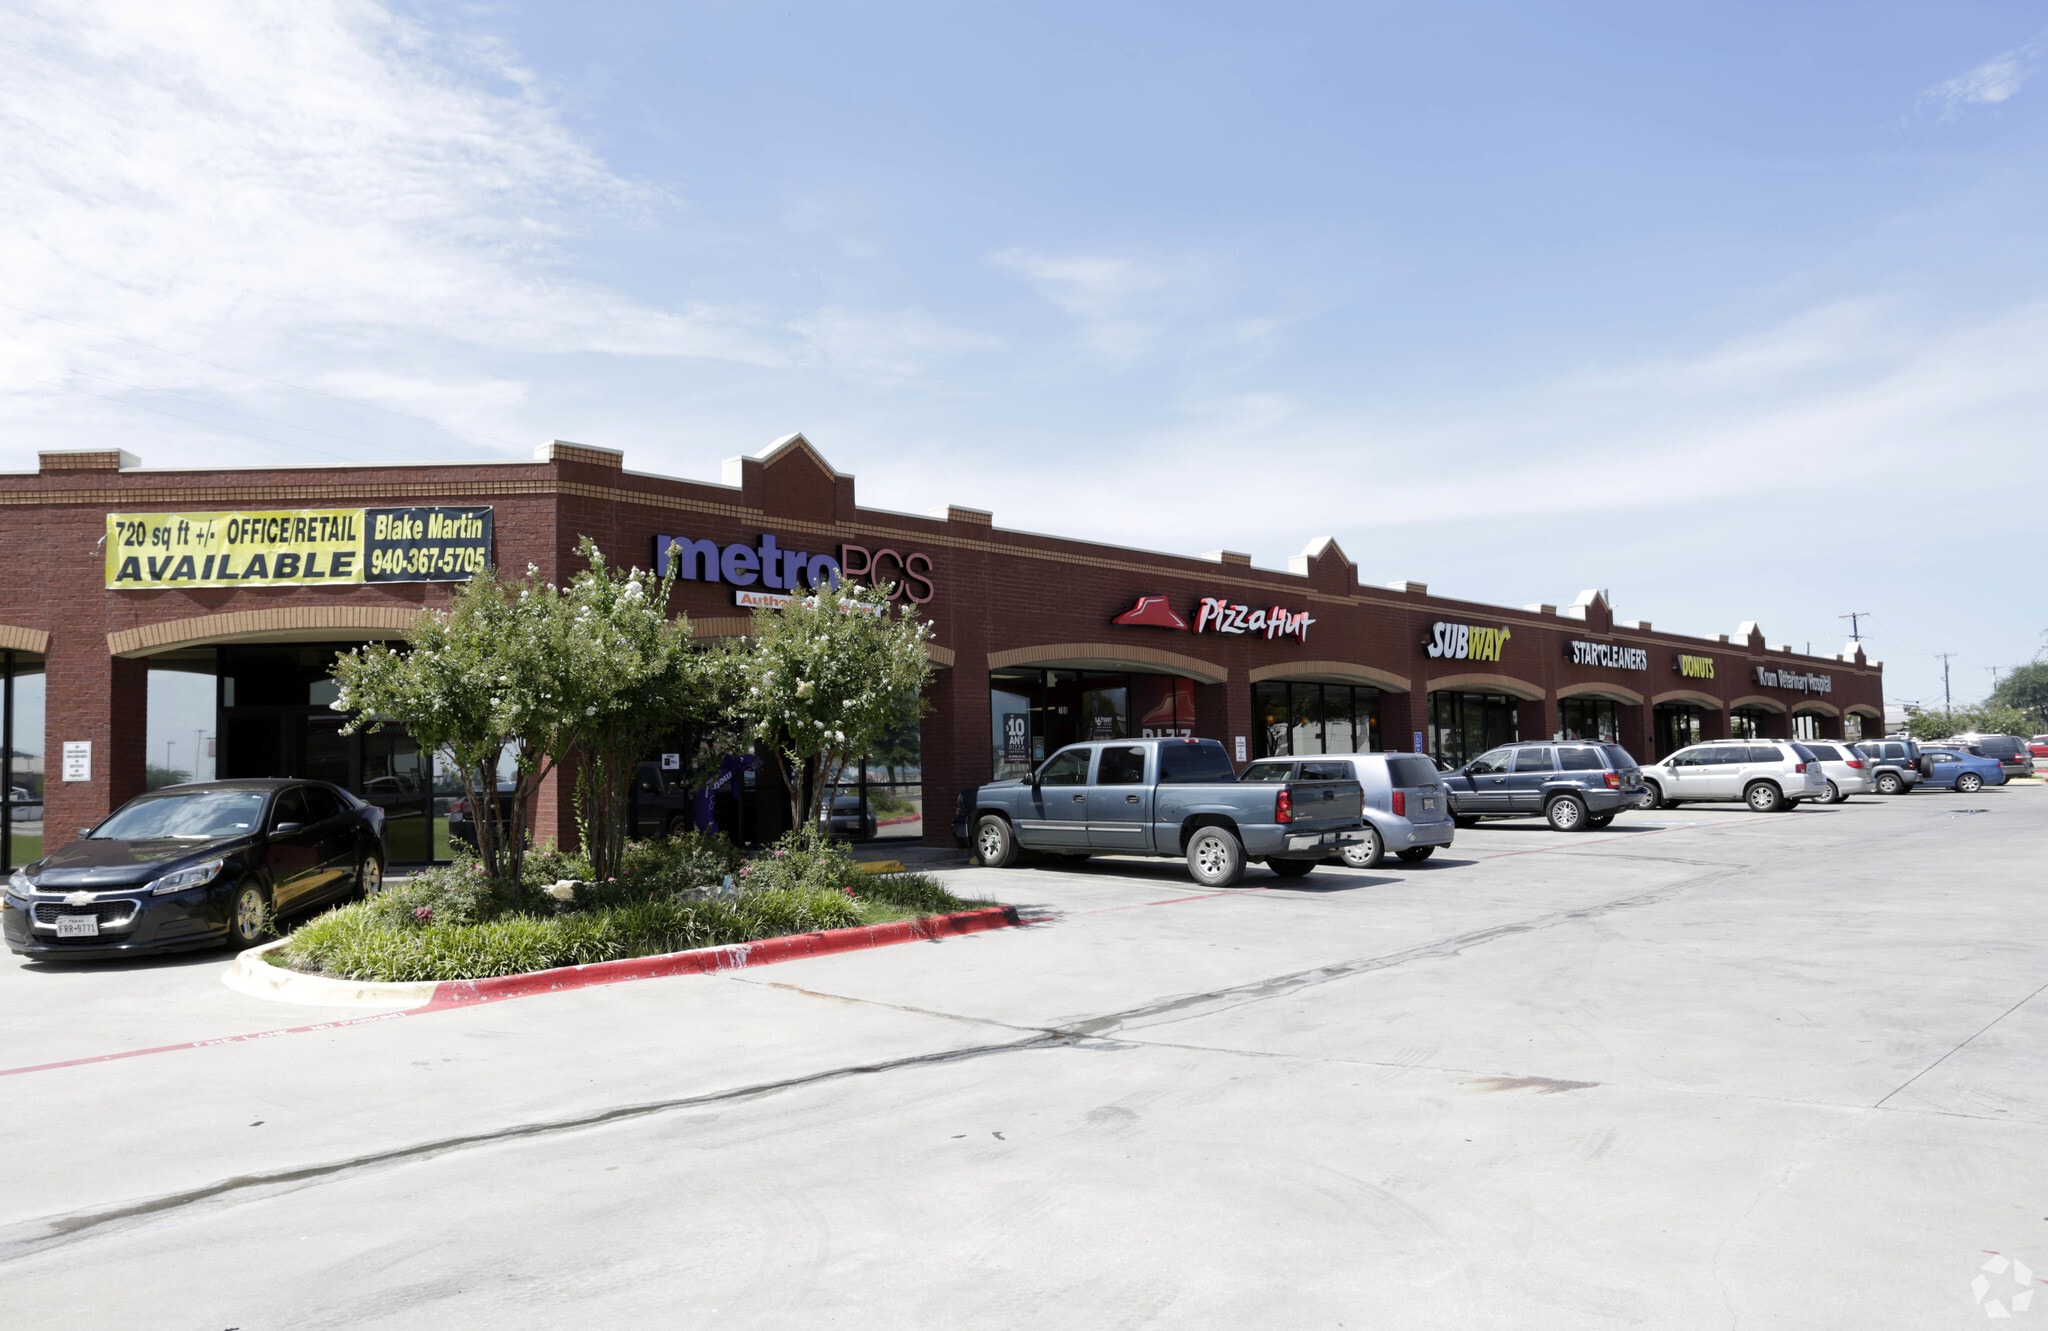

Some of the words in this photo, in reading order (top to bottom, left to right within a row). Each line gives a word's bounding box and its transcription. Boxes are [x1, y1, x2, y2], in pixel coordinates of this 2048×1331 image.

[115, 521, 146, 547] 720
[151, 525, 171, 551] sq
[176, 519, 190, 545] ft
[195, 519, 215, 548] +/-
[227, 516, 357, 545] OFFICE/RETAIL
[375, 515, 423, 540] Blake
[427, 512, 482, 538] Martin
[115, 551, 355, 582] AVAILABLE
[371, 546, 485, 575] 940-367-5705
[656, 533, 934, 604] metroPCS
[1427, 621, 1511, 662] SUBWAY
[1572, 640, 1599, 666] STAR
[1598, 645, 1647, 671] CLEANERS
[1680, 655, 1715, 680] DONUTS
[1757, 667, 1778, 687] Krum
[1807, 673, 1832, 696] Hospital
[1009, 736, 1025, 745] ANY
